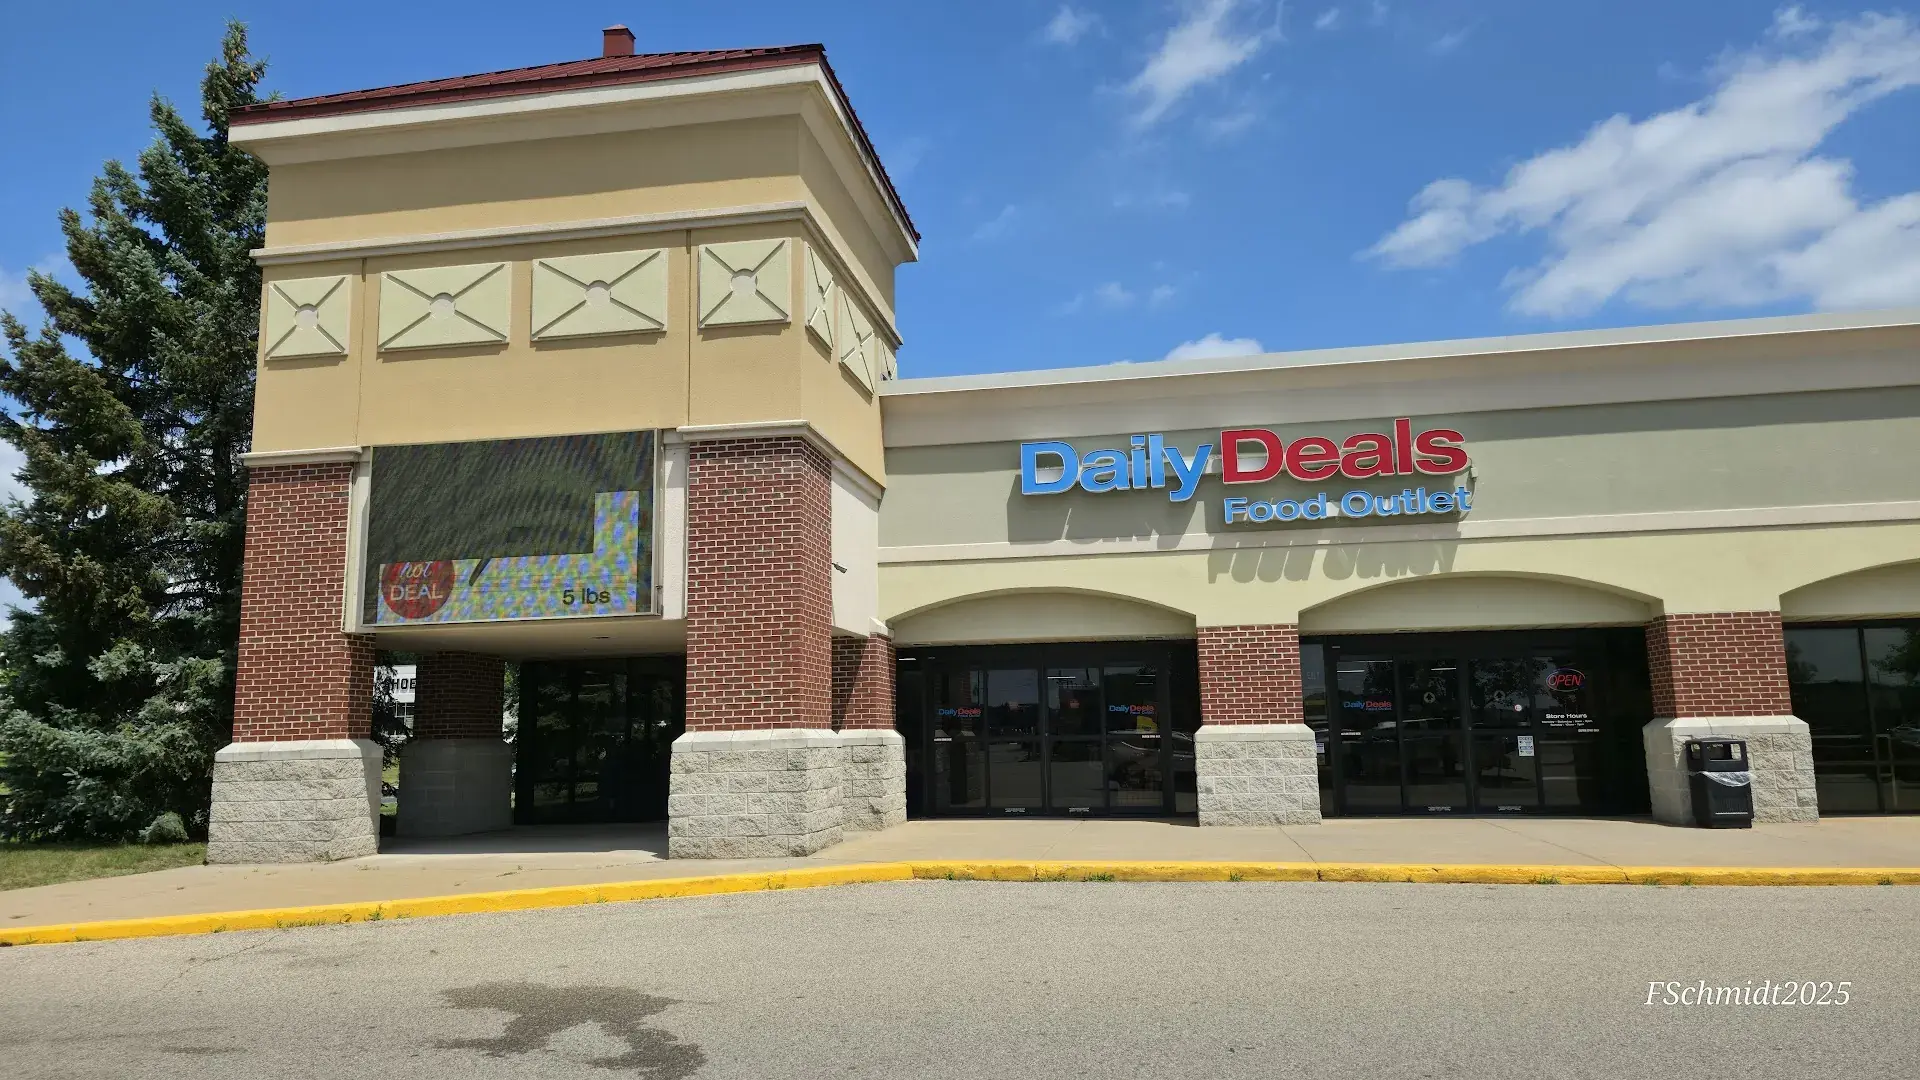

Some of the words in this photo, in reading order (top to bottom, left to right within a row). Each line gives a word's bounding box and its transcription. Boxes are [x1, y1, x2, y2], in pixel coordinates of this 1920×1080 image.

[1021, 434, 1213, 502] Daily
[1221, 418, 1469, 485] Deals
[1223, 493, 1327, 524] Food
[1341, 486, 1472, 517] Outlet
[390, 583, 443, 601] DEAL
[562, 589, 575, 605] 5
[582, 587, 611, 605] lbs
[1548, 674, 1582, 688] OPEN
[938, 708, 957, 716] Daily
[957, 707, 982, 715] Deals
[1109, 705, 1129, 713] Daily
[1129, 704, 1155, 712] Deals
[1343, 700, 1365, 709] Daily
[1365, 700, 1392, 708] Deals
